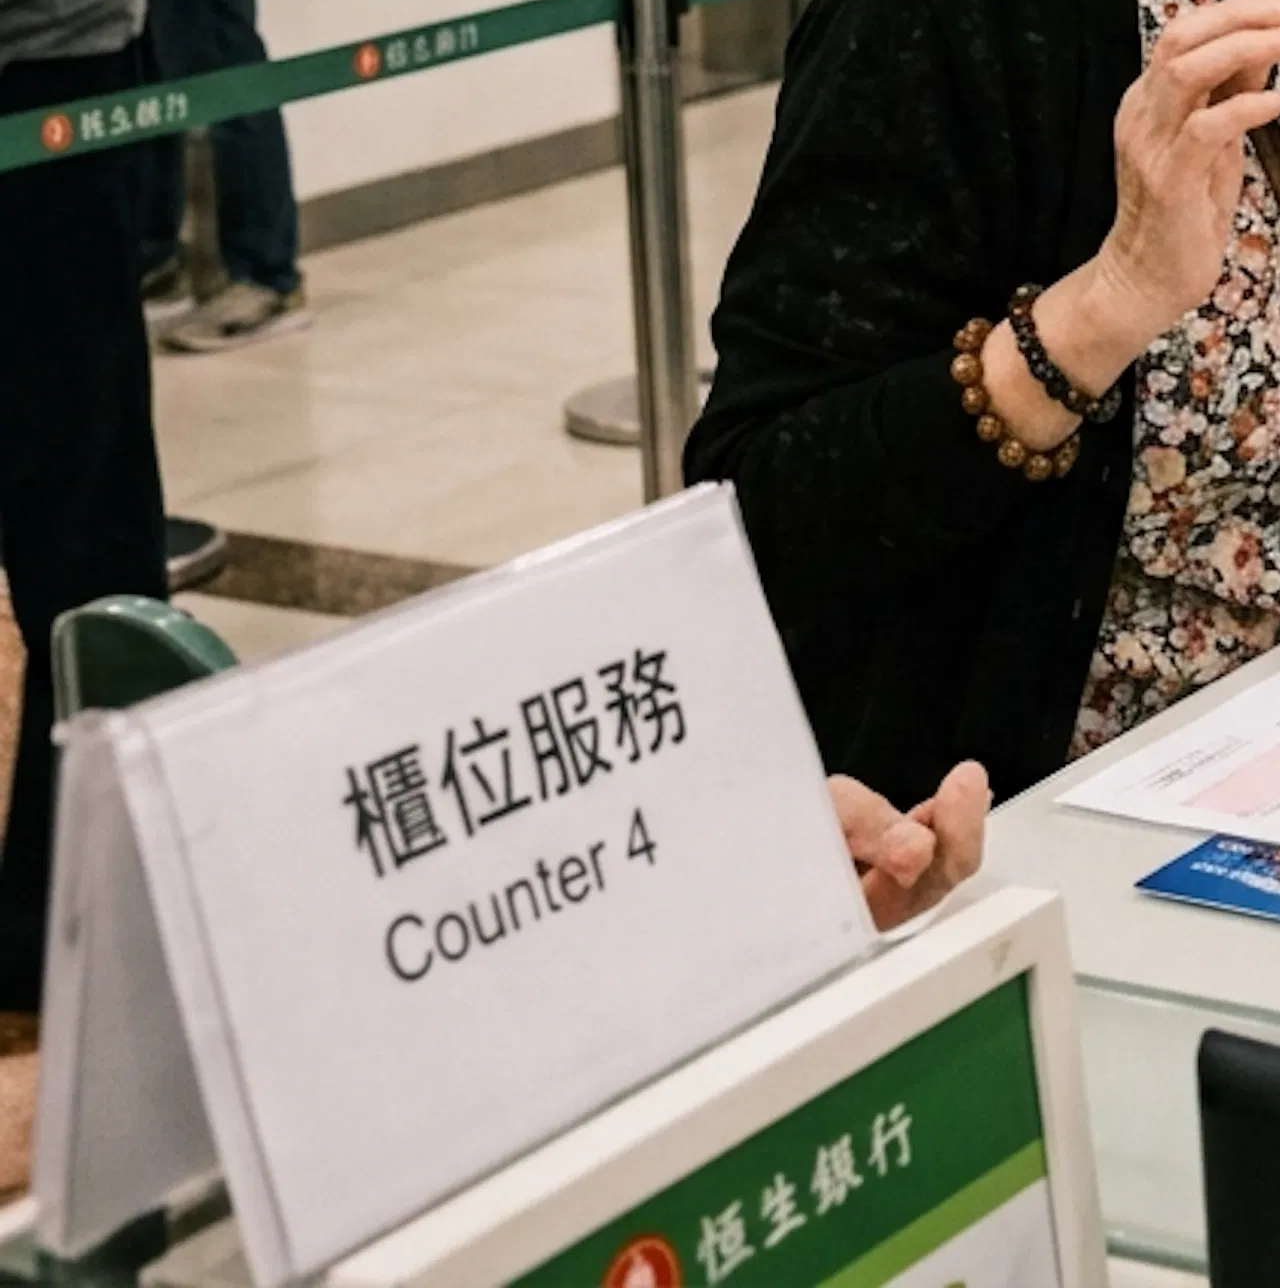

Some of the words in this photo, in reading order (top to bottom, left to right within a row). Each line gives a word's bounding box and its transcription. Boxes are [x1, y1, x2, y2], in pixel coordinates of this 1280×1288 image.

[342, 647, 690, 880] 櫃位服務
[384, 839, 608, 983] Counter
[625, 807, 659, 867] 4
[696, 1101, 913, 1286] 恒生銀行
